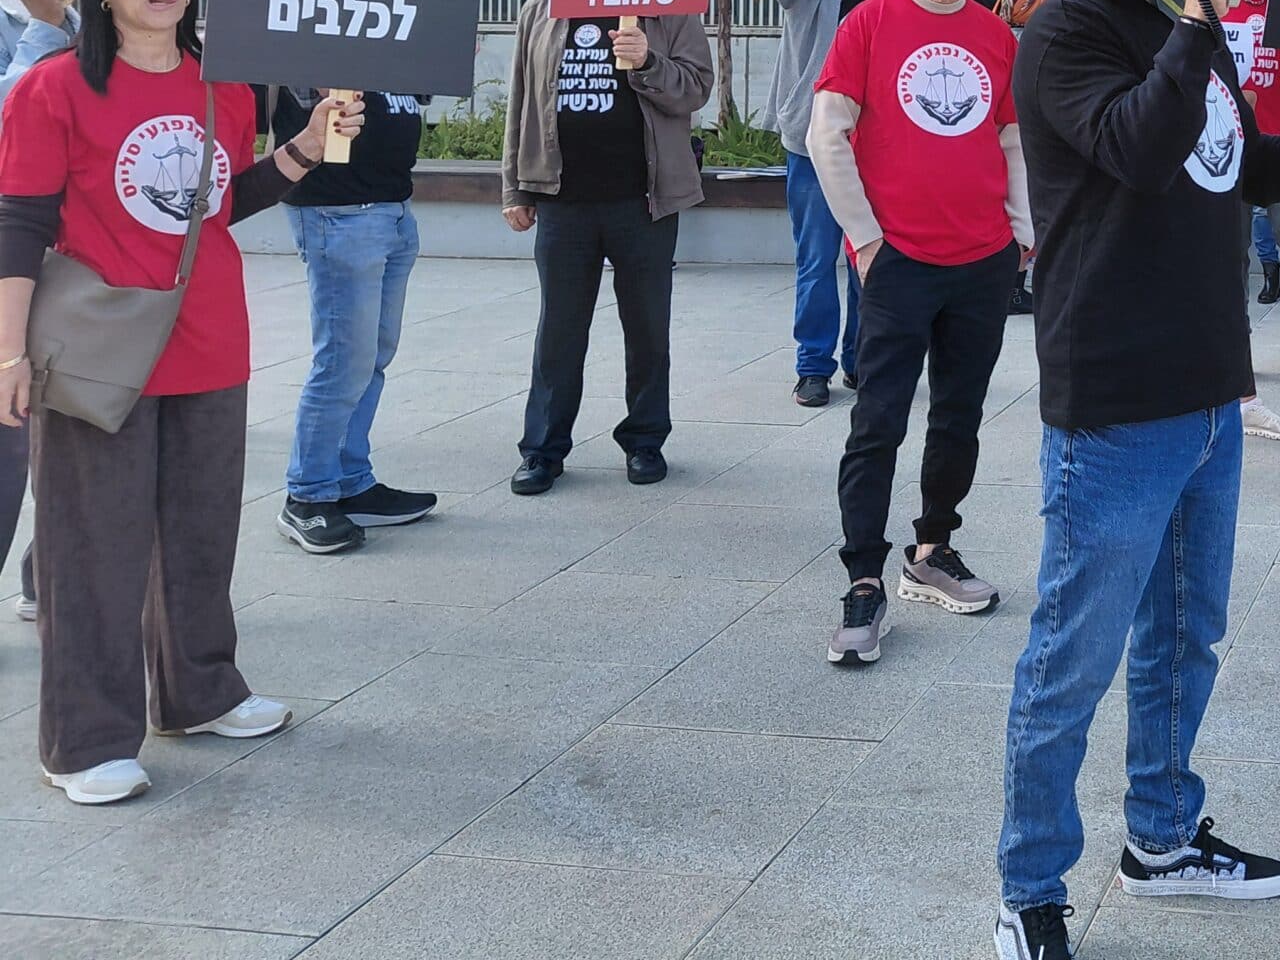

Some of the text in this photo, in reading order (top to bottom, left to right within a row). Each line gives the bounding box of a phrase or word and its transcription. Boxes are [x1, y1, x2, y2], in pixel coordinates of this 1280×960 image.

[576, 48, 609, 61] עמית
[584, 62, 613, 78] הזמן
[900, 47, 990, 104] עמותת נפגעי סלייס
[588, 79, 618, 90] רשת
[119, 119, 228, 198] עמות נפגעי סלייס
